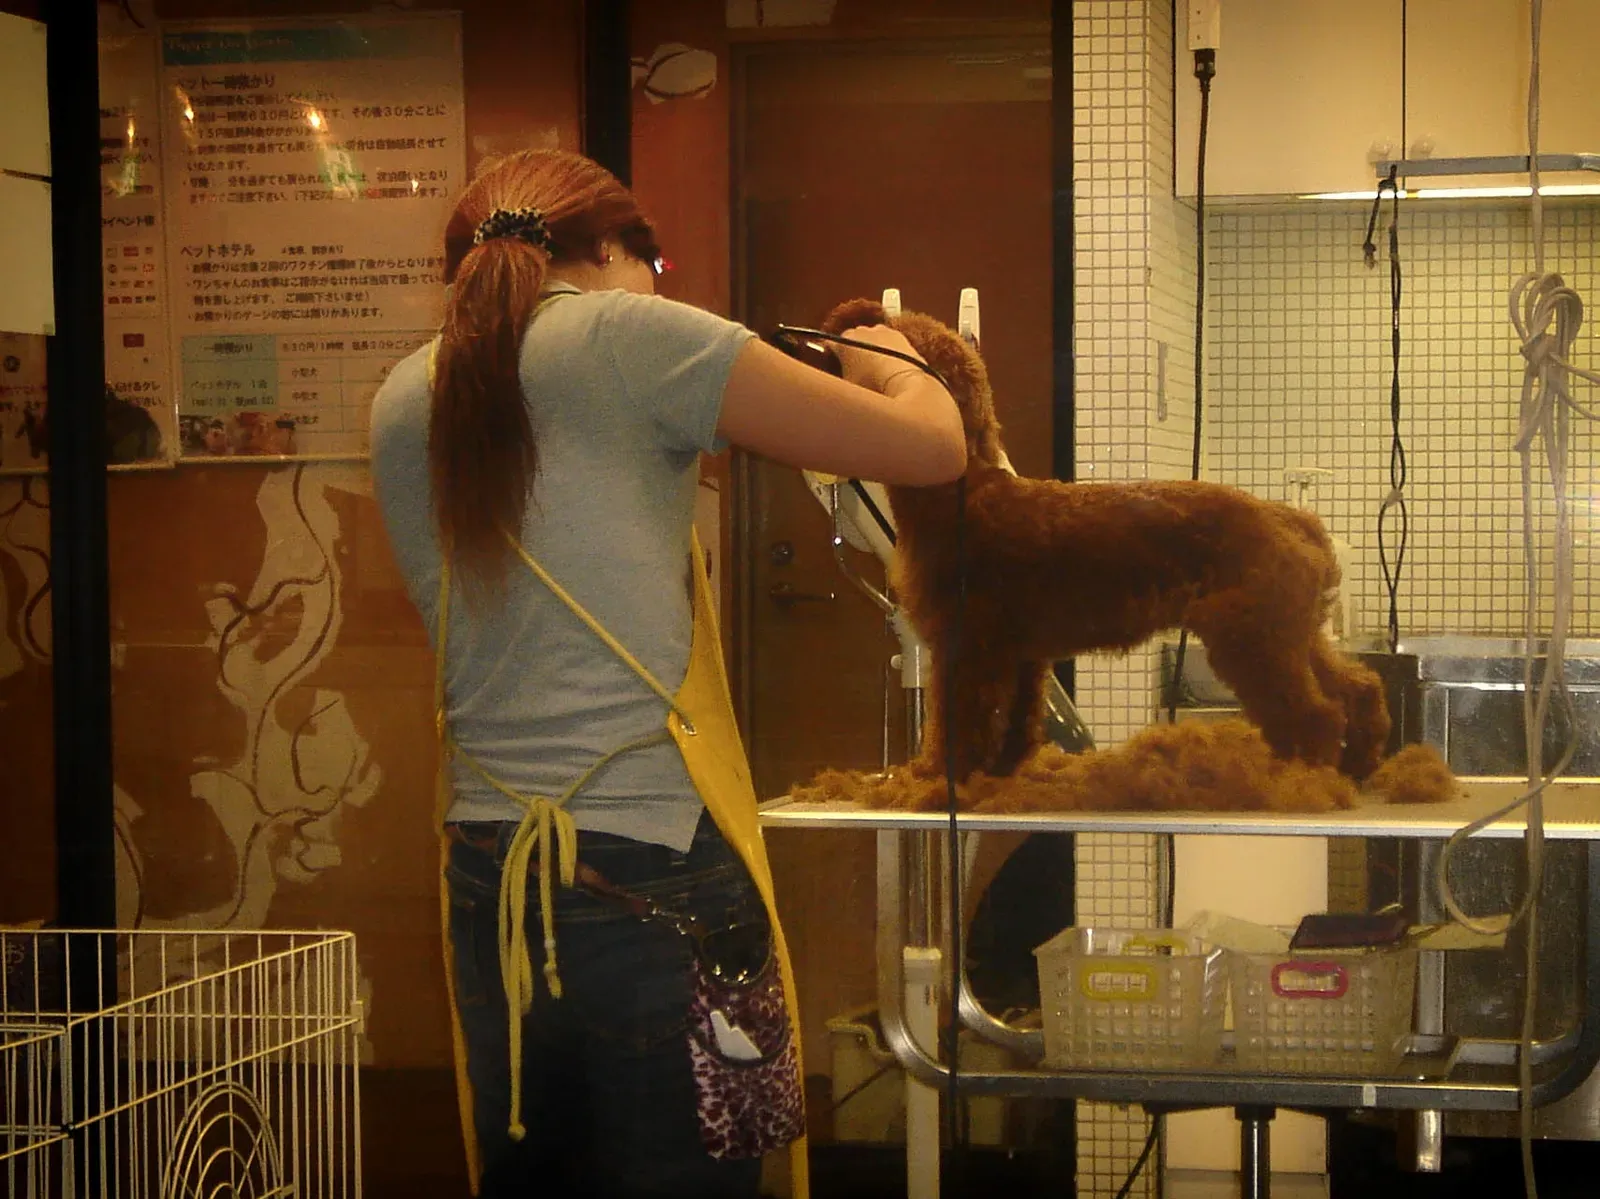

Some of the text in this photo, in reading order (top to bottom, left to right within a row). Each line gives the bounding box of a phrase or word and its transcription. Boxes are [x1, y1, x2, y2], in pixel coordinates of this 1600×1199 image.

[180, 244, 255, 257] ペットホテル
